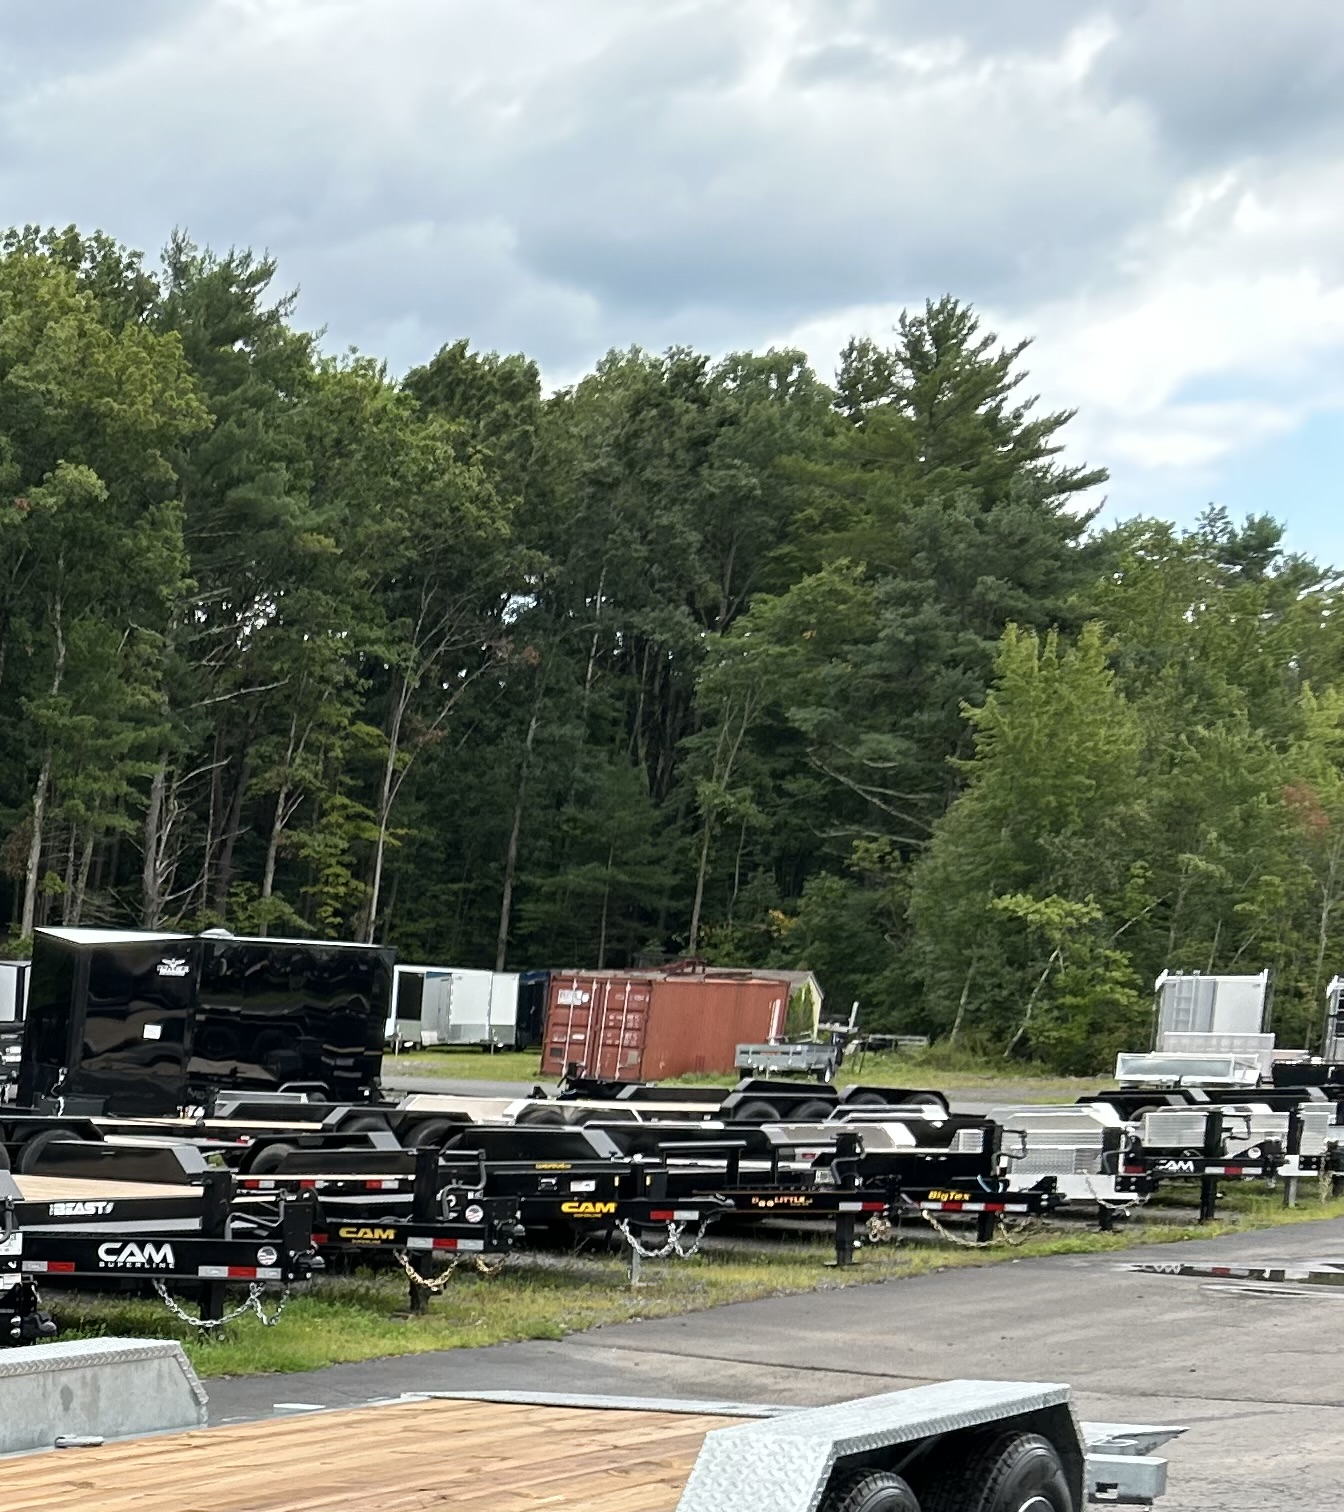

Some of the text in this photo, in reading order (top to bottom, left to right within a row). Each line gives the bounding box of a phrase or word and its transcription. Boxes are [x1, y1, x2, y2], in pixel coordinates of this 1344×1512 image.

[561, 1202, 617, 1213] CAM
[338, 1226, 396, 1240] CAM
[97, 1242, 175, 1263] CAM
